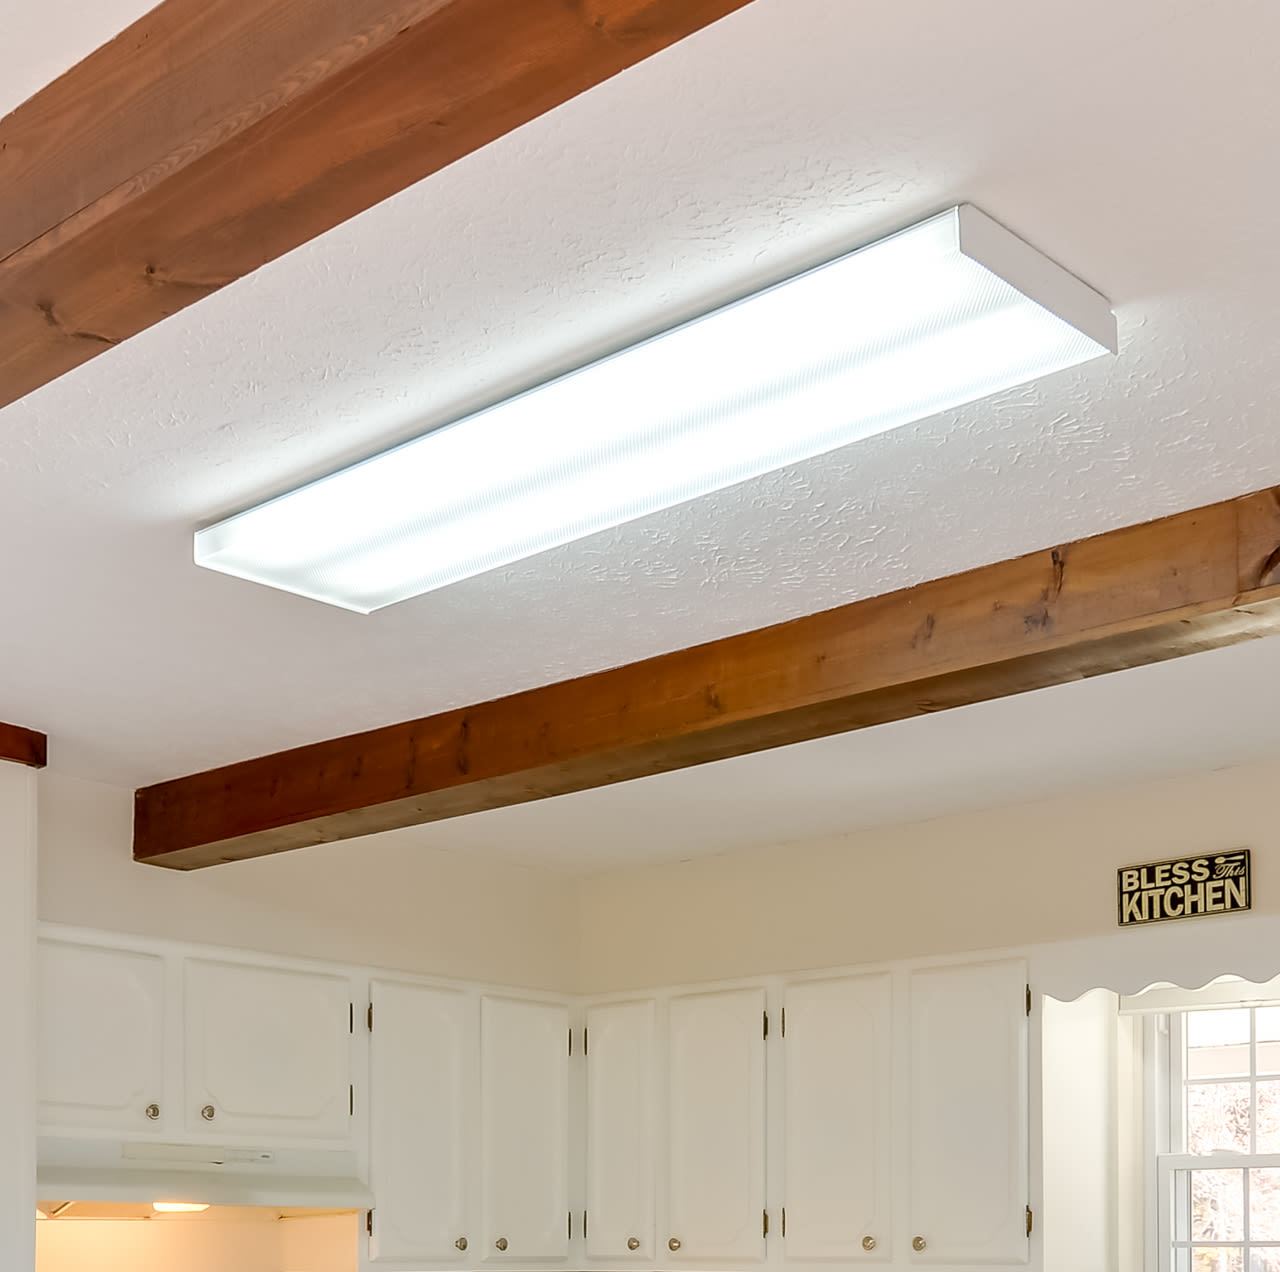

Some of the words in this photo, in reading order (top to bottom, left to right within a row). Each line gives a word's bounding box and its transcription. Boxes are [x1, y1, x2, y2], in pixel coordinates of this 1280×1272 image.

[1122, 859, 1210, 892] BLESS
[1212, 862, 1245, 879] This
[1122, 877, 1246, 923] KITCHEN
